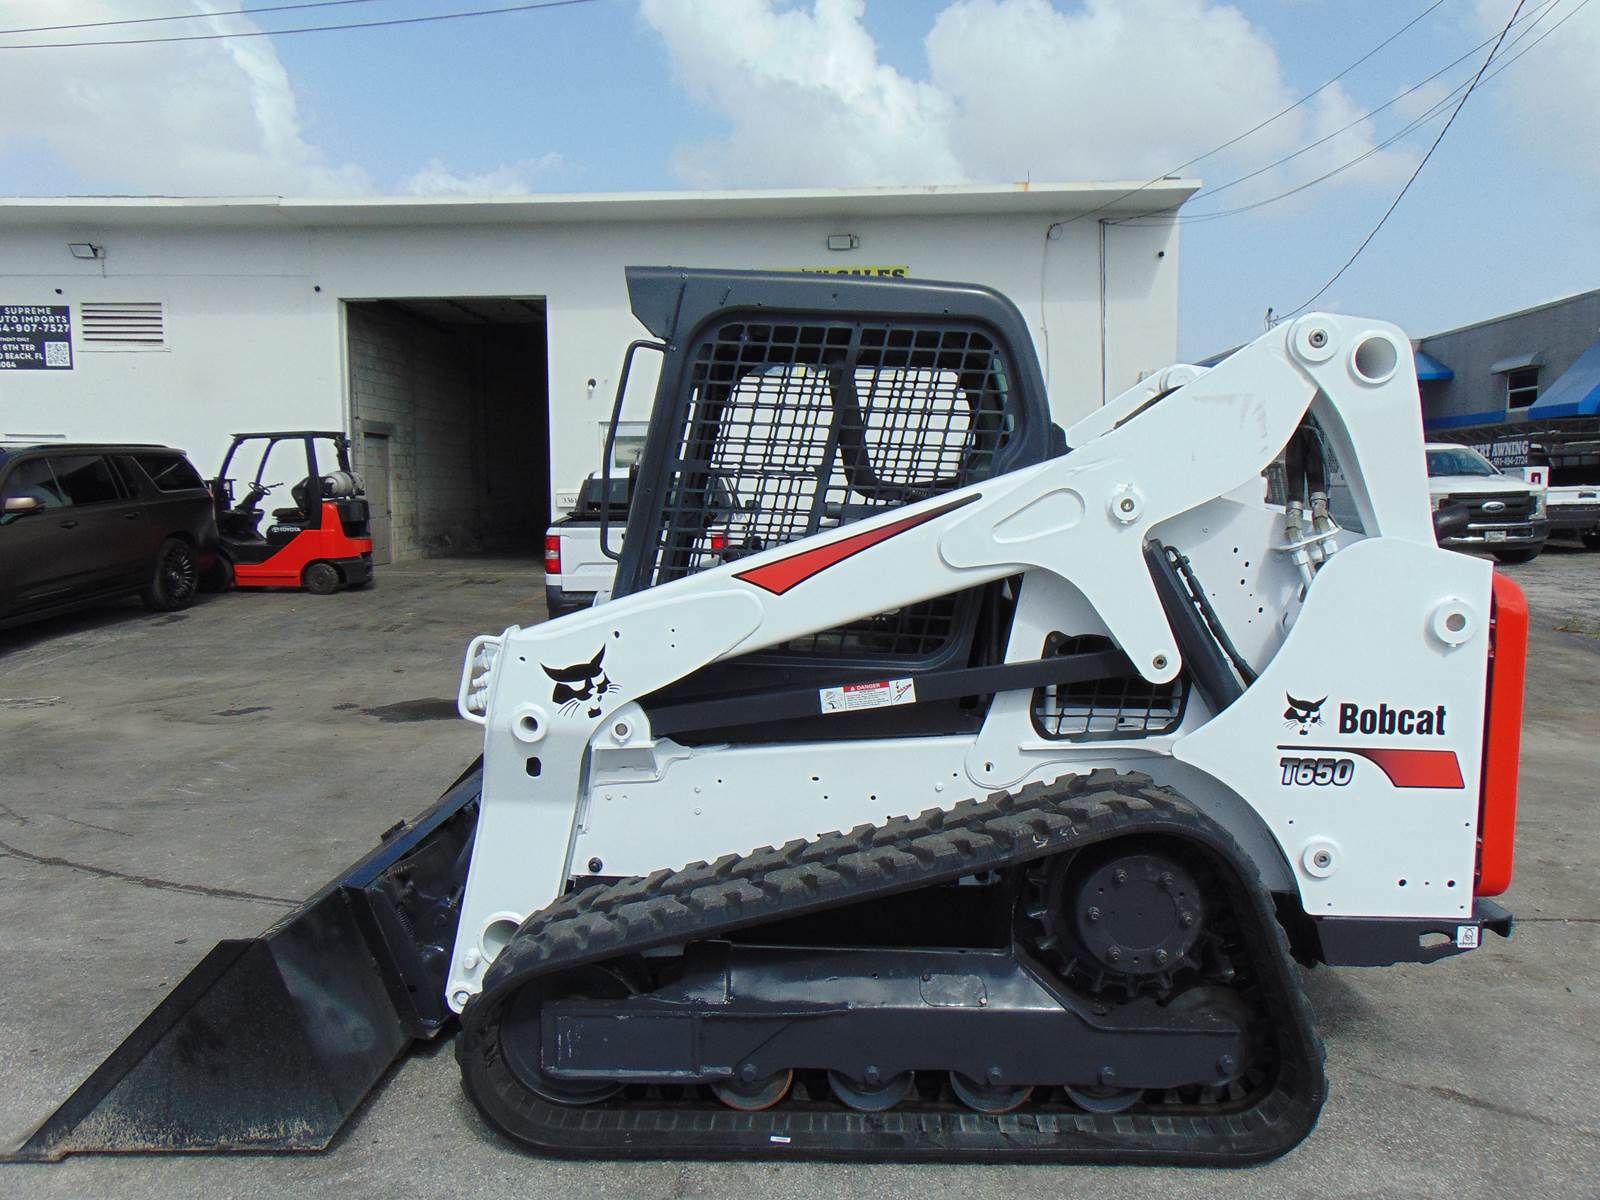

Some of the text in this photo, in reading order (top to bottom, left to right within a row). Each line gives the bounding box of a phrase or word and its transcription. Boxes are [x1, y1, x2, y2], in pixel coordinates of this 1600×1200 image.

[4, 307, 52, 315] SUPREME
[21, 315, 68, 323] IMPORTS
[0, 324, 70, 333] 4-907-7527
[4, 352, 34, 360] BEACH,
[34, 352, 44, 360] FL
[1491, 440, 1529, 457] AWNING
[856, 682, 881, 690] DANGER
[1338, 702, 1447, 736] Bobcat
[1280, 757, 1355, 786] T650
